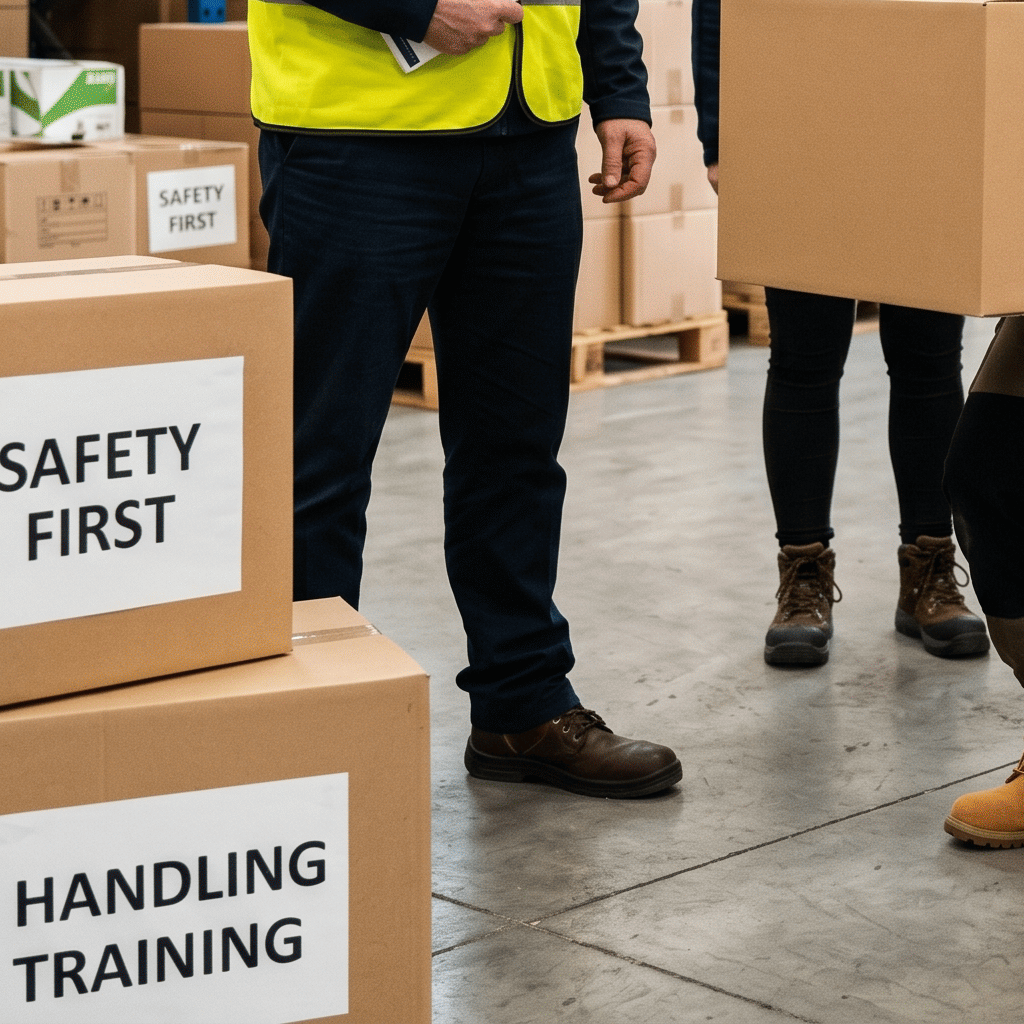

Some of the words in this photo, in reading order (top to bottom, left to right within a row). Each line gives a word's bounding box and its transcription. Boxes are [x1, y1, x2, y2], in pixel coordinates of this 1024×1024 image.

[159, 184, 225, 208] SAFETY
[168, 211, 217, 234] FIRST
[0, 423, 201, 492] SAFETY
[27, 495, 176, 561] FIRST
[16, 840, 327, 927] HANDLING
[12, 916, 303, 1003] TRAINING
